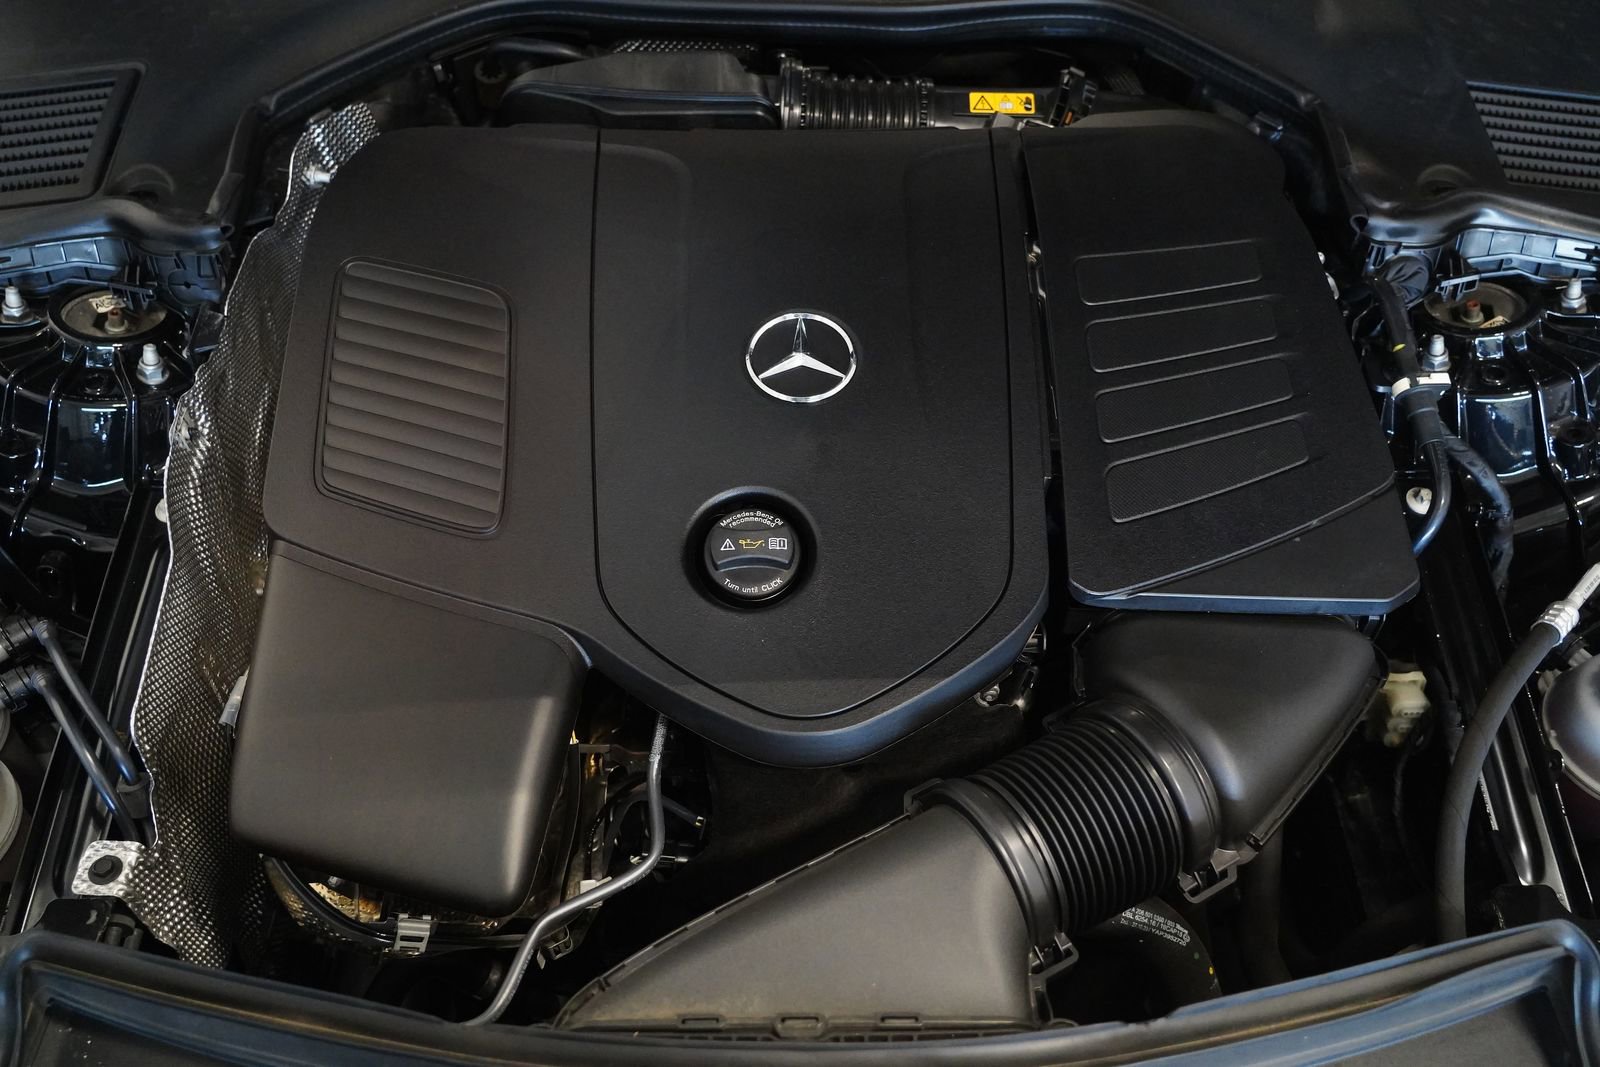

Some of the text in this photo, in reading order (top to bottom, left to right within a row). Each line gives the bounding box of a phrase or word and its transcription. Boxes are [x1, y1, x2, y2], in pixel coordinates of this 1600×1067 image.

[720, 511, 784, 527] Mercedes-Benz Oil
[729, 516, 776, 528] recommended
[724, 578, 740, 591] Turn
[761, 577, 783, 592] CLICK
